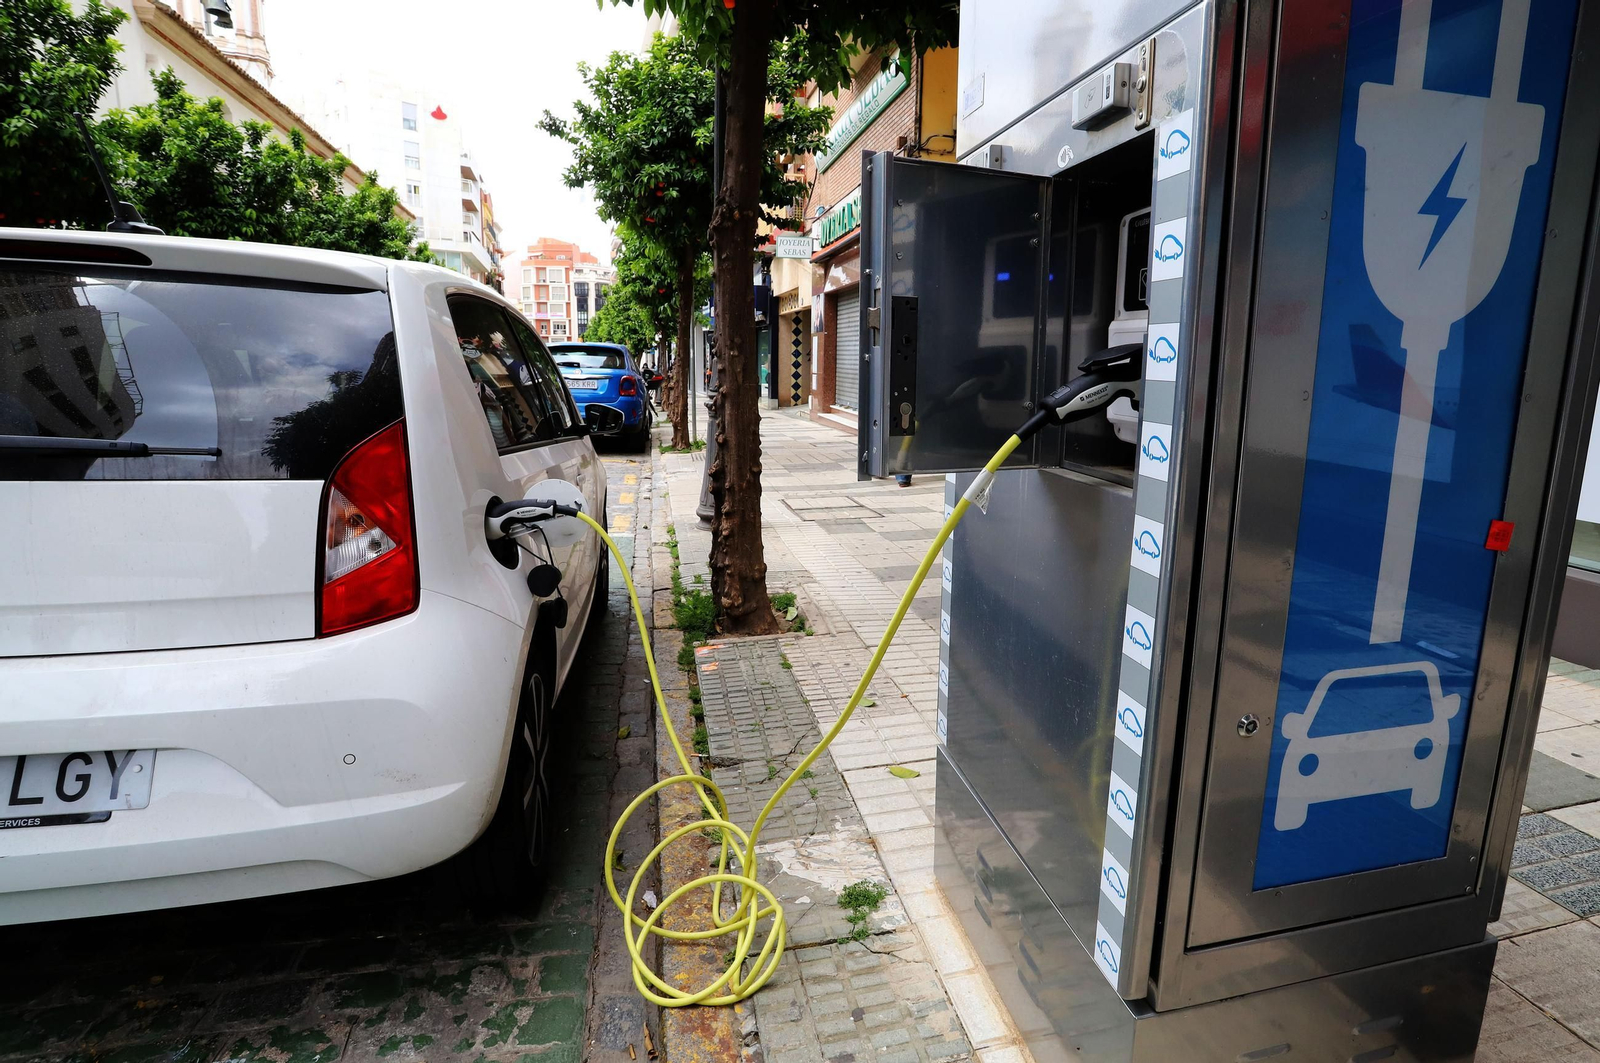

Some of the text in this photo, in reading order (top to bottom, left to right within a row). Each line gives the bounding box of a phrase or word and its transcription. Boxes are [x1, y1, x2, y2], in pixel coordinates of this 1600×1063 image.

[859, 99, 880, 124] REGALO
[778, 239, 811, 247] JOYERIA
[783, 248, 807, 256] SEBAS
[565, 380, 580, 388] 565
[8, 749, 137, 806] LGY
